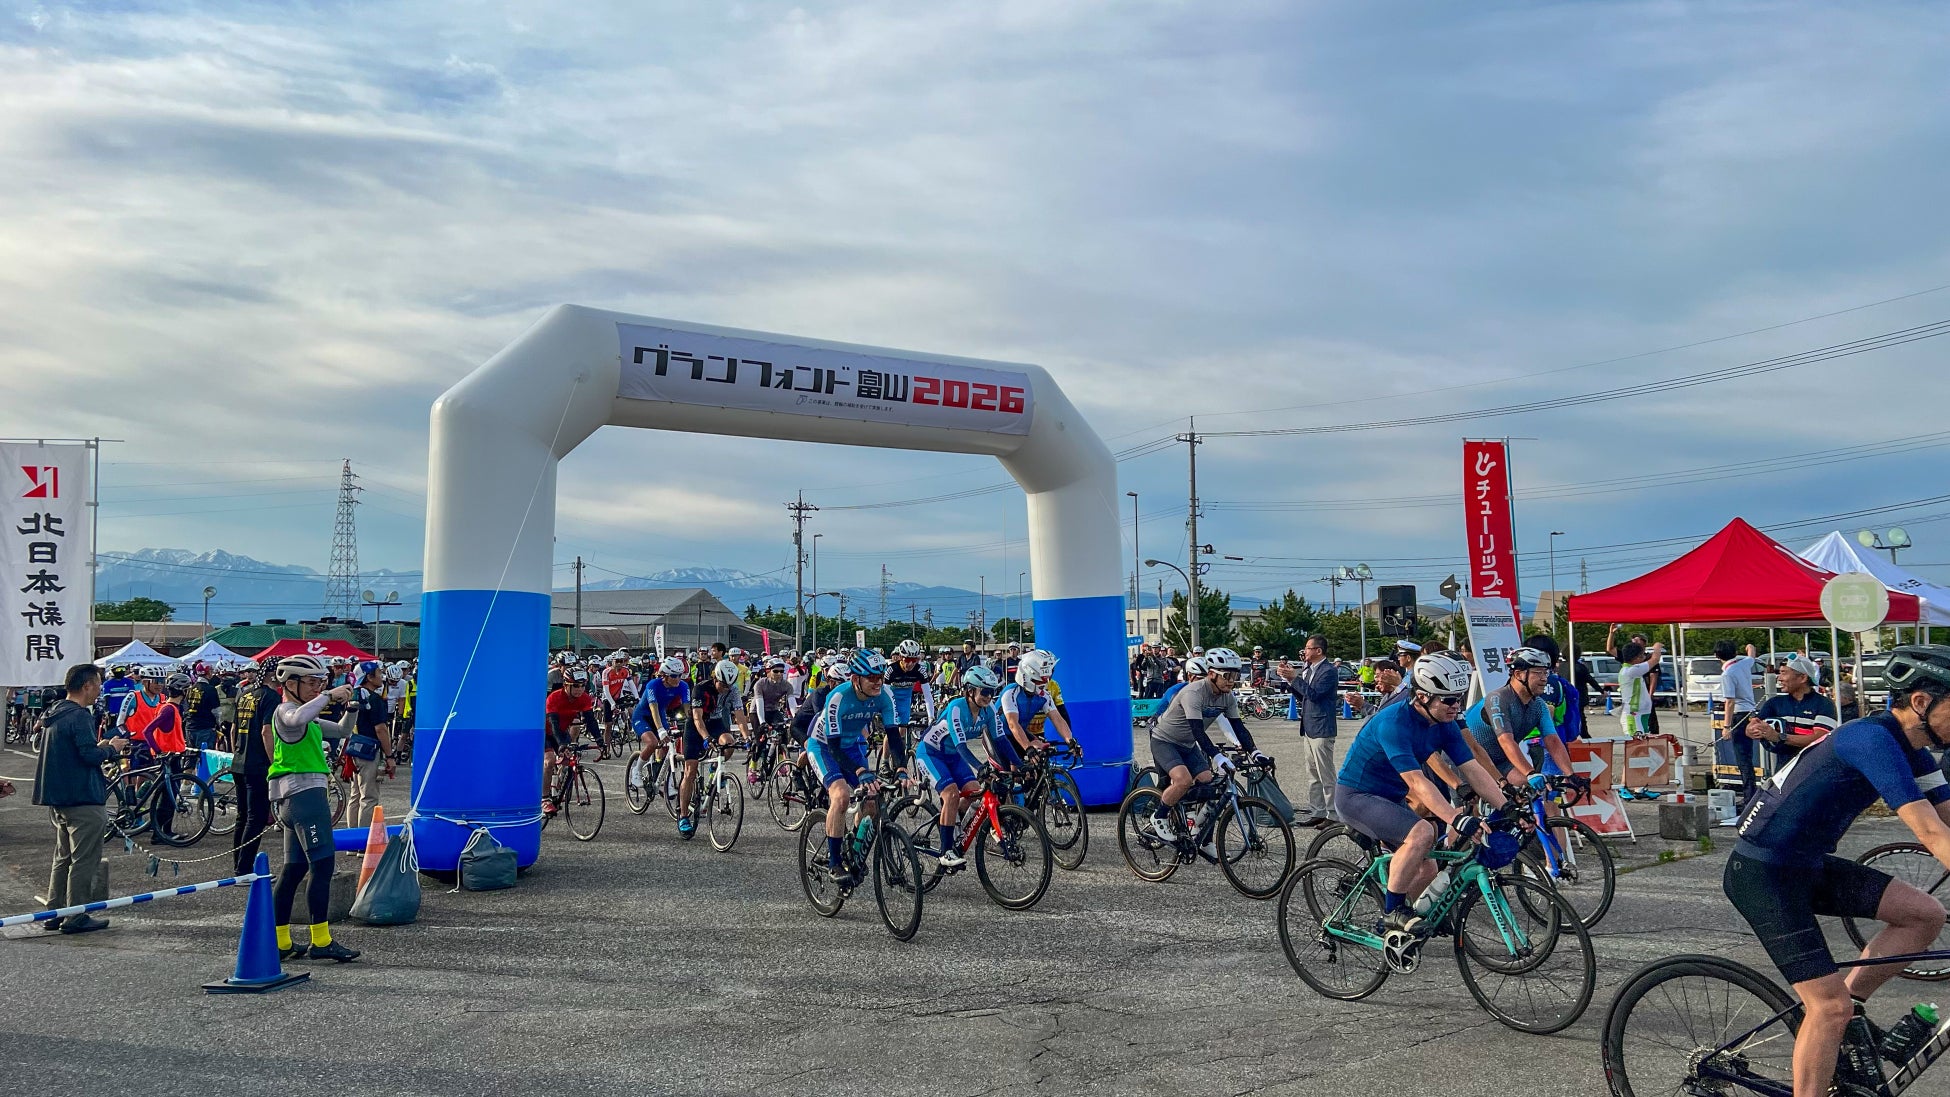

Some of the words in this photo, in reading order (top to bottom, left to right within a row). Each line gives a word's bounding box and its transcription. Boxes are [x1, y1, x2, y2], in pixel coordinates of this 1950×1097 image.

[1476, 479, 1503, 598] チューリップ
[1840, 610, 1868, 619] TAXI
[1430, 876, 1465, 923] anchi
[1486, 892, 1509, 934] Bianchi
